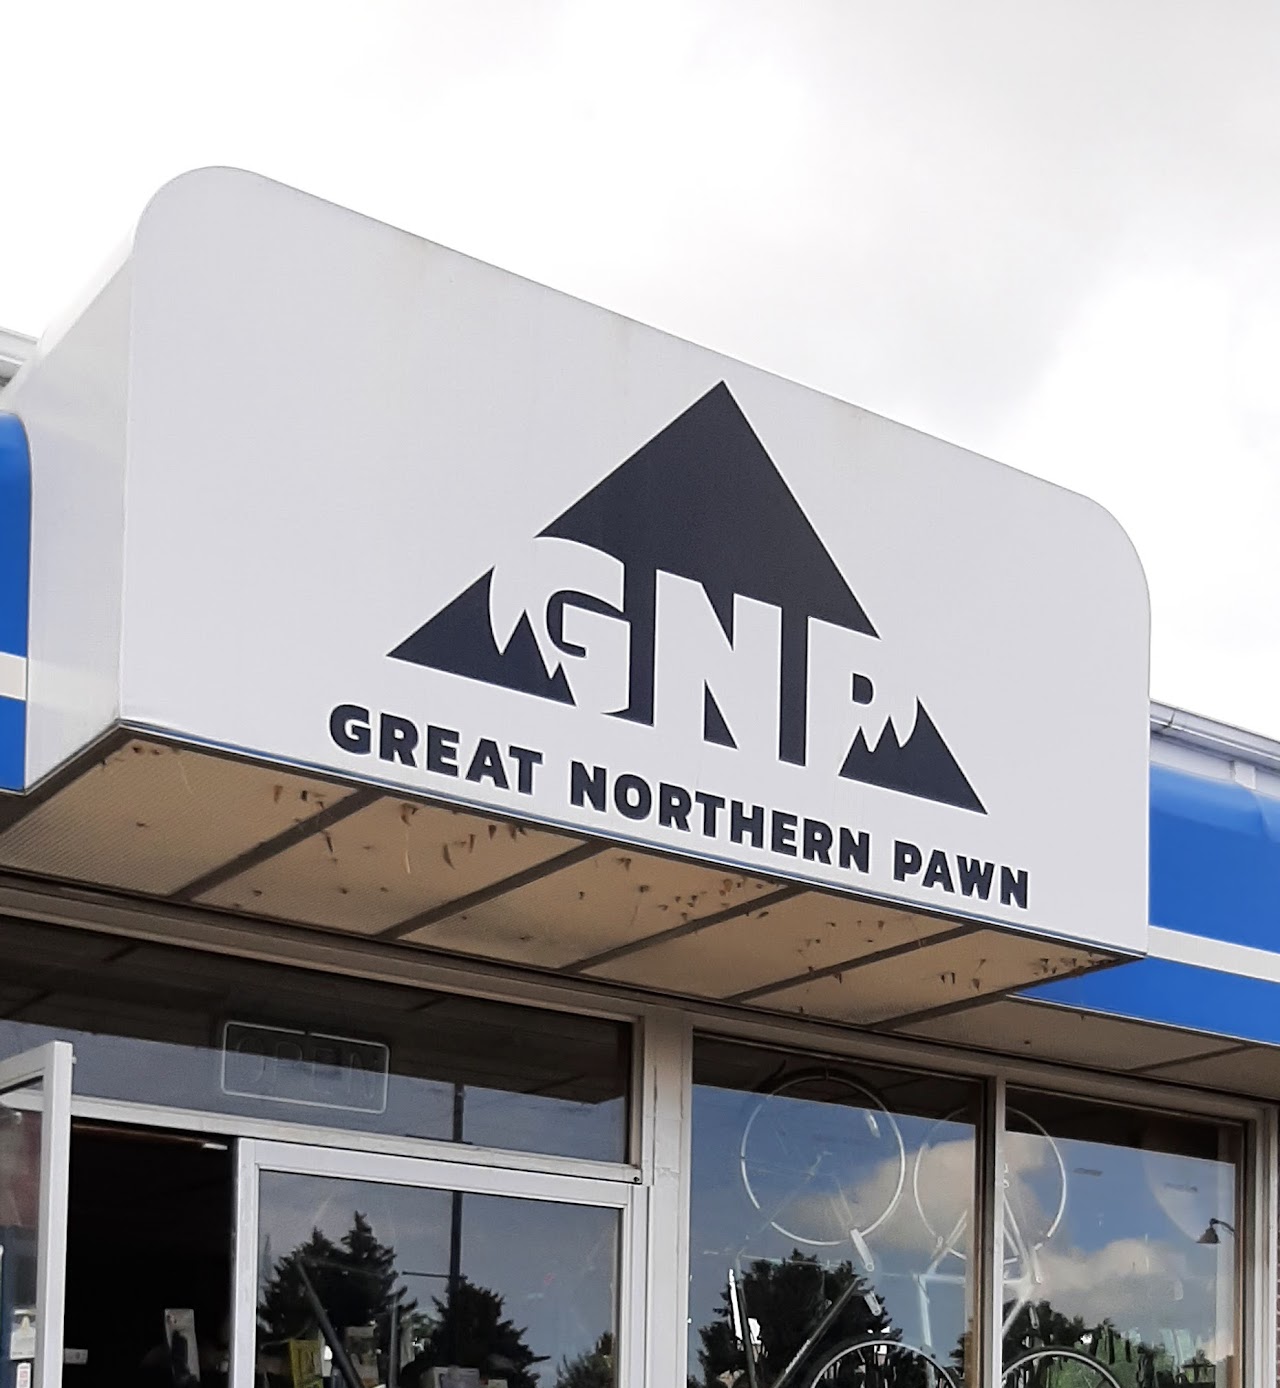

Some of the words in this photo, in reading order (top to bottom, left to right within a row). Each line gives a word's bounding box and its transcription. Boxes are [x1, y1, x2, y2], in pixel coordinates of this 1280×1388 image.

[489, 534, 916, 773] GNP
[329, 704, 543, 796] GREAT
[570, 760, 870, 874] NORTHERN
[893, 840, 1029, 910] PAWN
